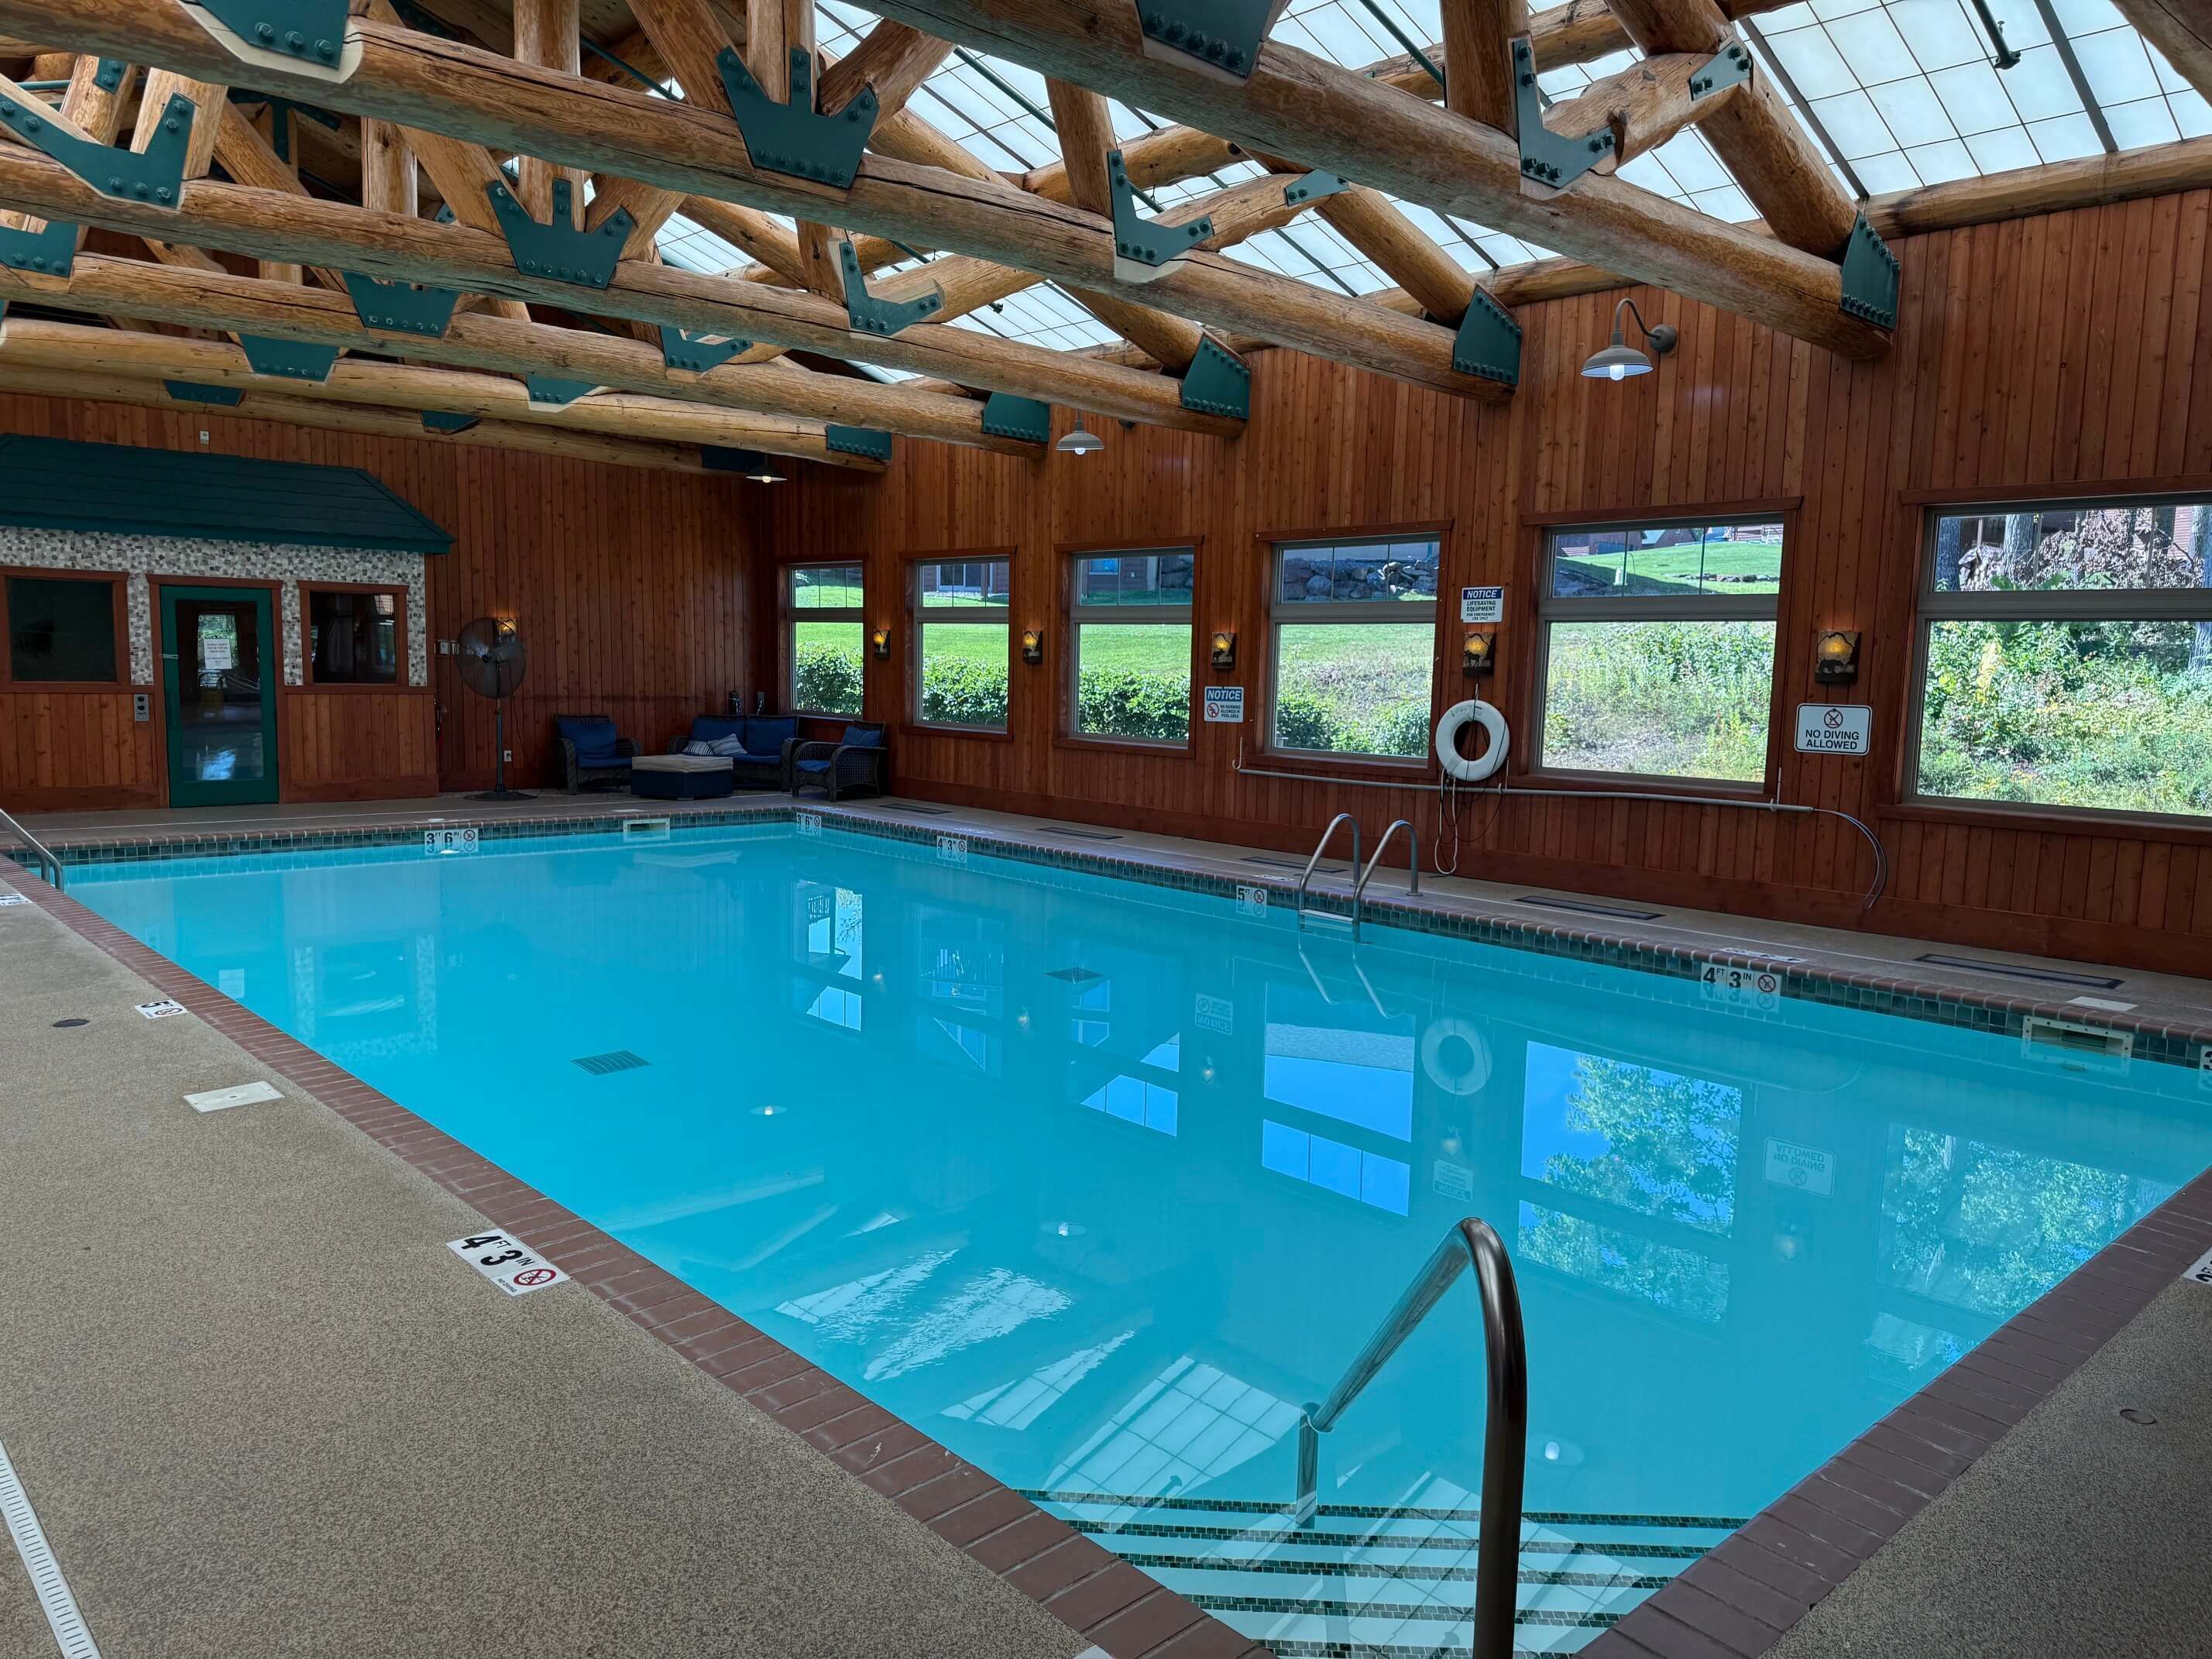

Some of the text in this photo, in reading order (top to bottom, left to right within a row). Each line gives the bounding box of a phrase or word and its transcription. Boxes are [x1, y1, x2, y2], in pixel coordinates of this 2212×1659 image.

[1467, 589, 1498, 599] NOTICE
[1207, 690, 1242, 700] NOTICE
[1805, 730, 1860, 740] NO DIVING
[1806, 740, 1857, 750] ALLOWED
[427, 833, 434, 843] 3
[445, 832, 453, 843] 6
[948, 840, 953, 850] 3
[1238, 888, 1245, 901] 5
[1703, 967, 1716, 984] 4
[1729, 971, 1741, 988] 3
[461, 1235, 512, 1250] 4 FT
[480, 1250, 536, 1266] 3 IN
